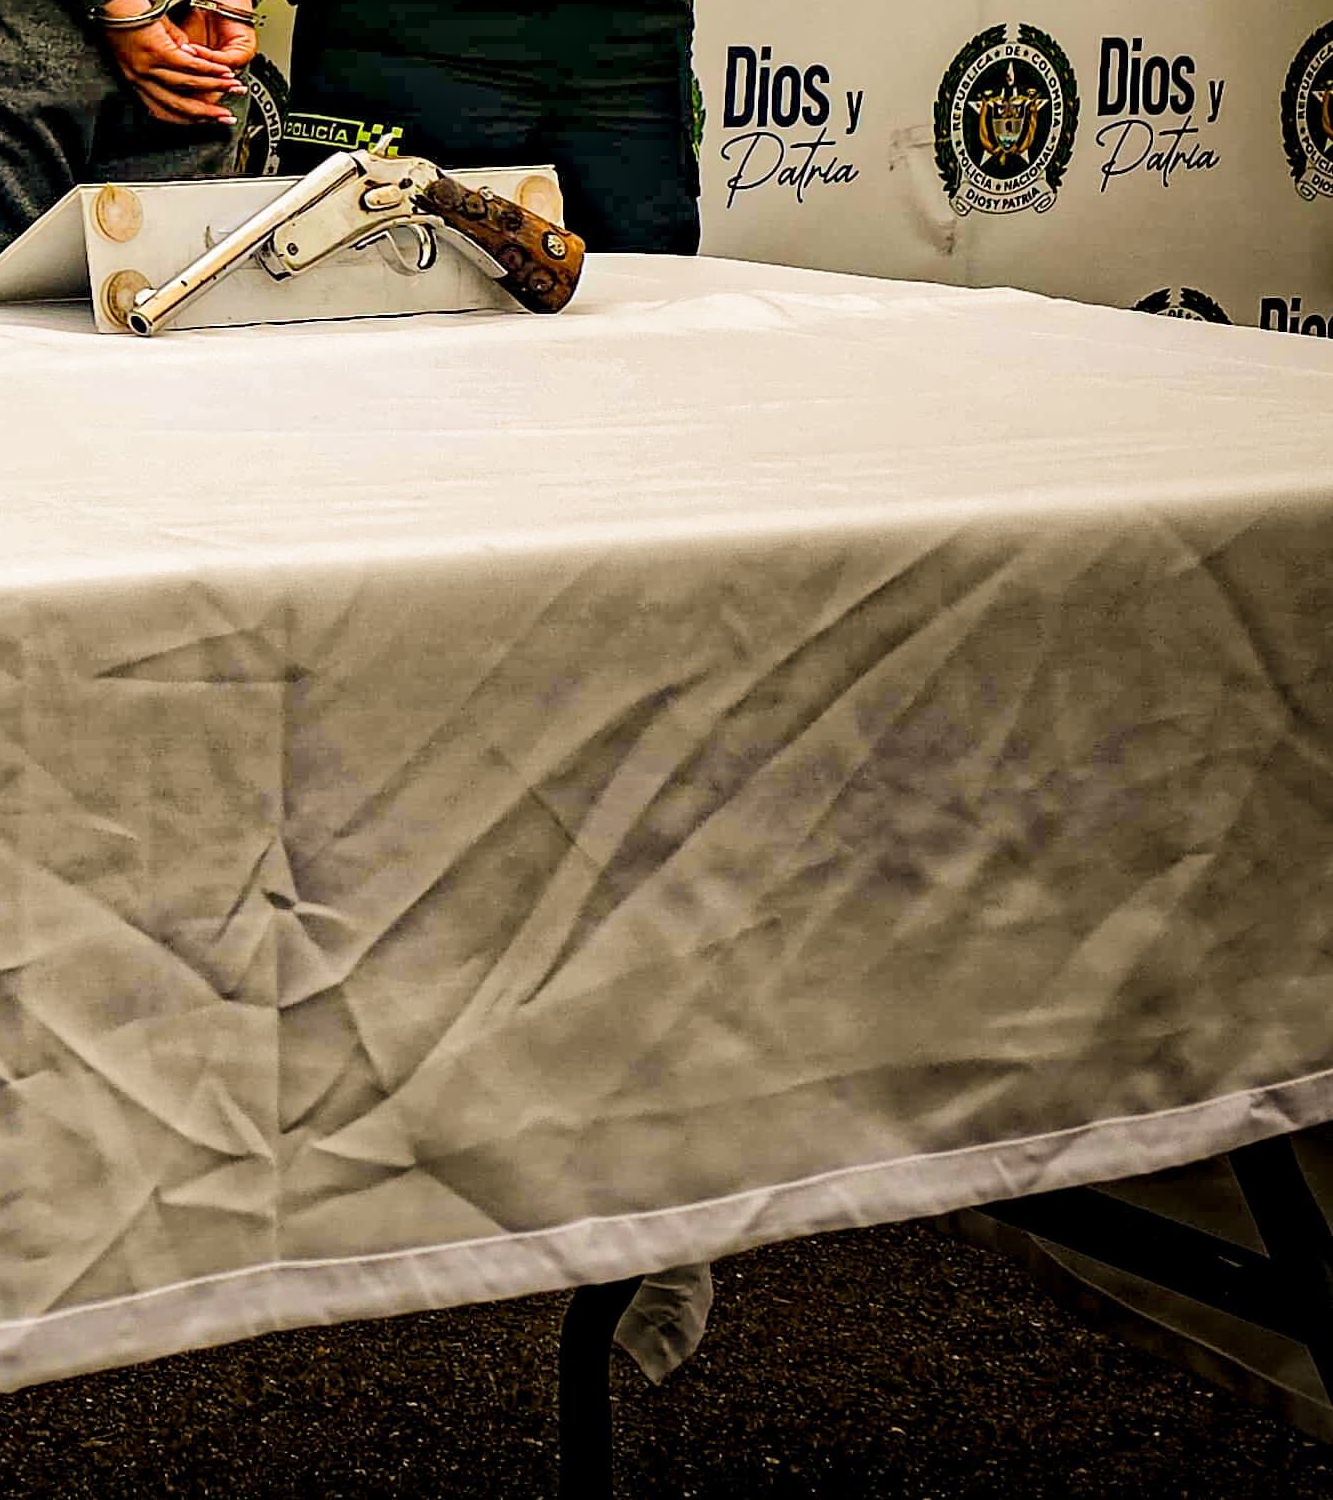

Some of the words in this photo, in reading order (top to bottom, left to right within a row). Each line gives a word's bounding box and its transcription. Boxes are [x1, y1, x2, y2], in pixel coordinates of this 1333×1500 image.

[724, 46, 829, 128] Dios
[846, 91, 863, 134] y
[1098, 38, 1194, 116] Dios
[1208, 80, 1224, 122] y
[721, 127, 859, 208] Patria
[1096, 115, 1220, 192] Patria
